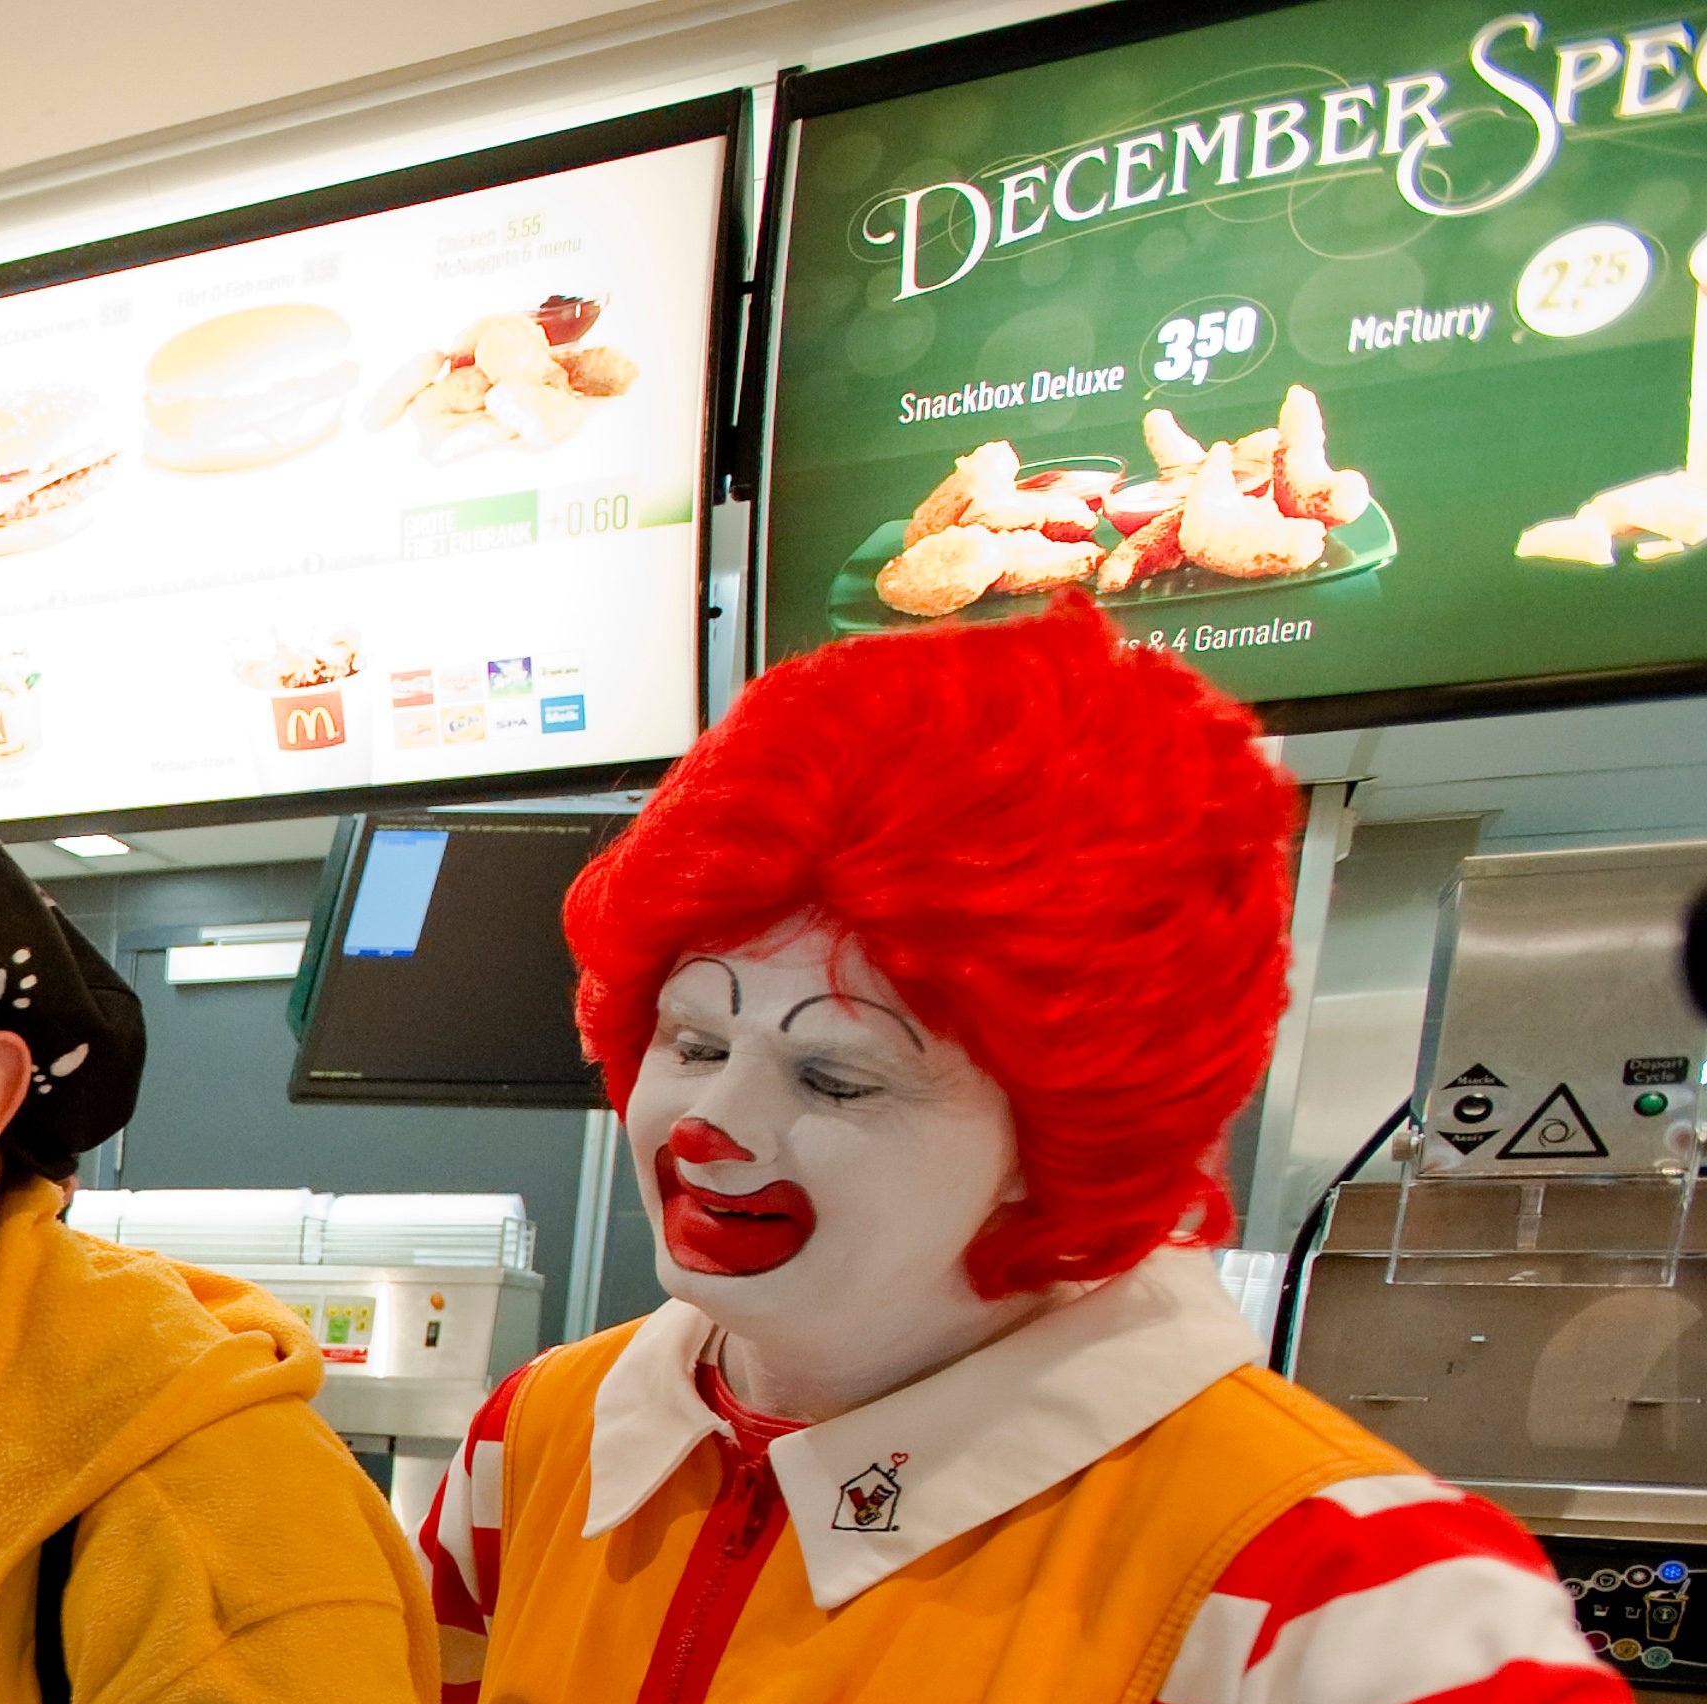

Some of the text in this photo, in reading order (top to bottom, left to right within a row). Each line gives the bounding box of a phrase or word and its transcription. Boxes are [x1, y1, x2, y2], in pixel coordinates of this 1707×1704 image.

[864, 13, 1707, 303] DECEMBER SPE
[507, 215, 541, 241] 5.55
[539, 237, 583, 259] menu
[1536, 247, 1630, 316] 2,25
[1154, 306, 1257, 387] 3,50
[1349, 302, 1491, 354] McFlurry
[899, 363, 1124, 425] Snackbox Deluxe
[474, 523, 532, 552] DRANK
[567, 494, 629, 537] 0.60
[1172, 628, 1187, 652] 4
[1195, 617, 1312, 651] Garnalen
